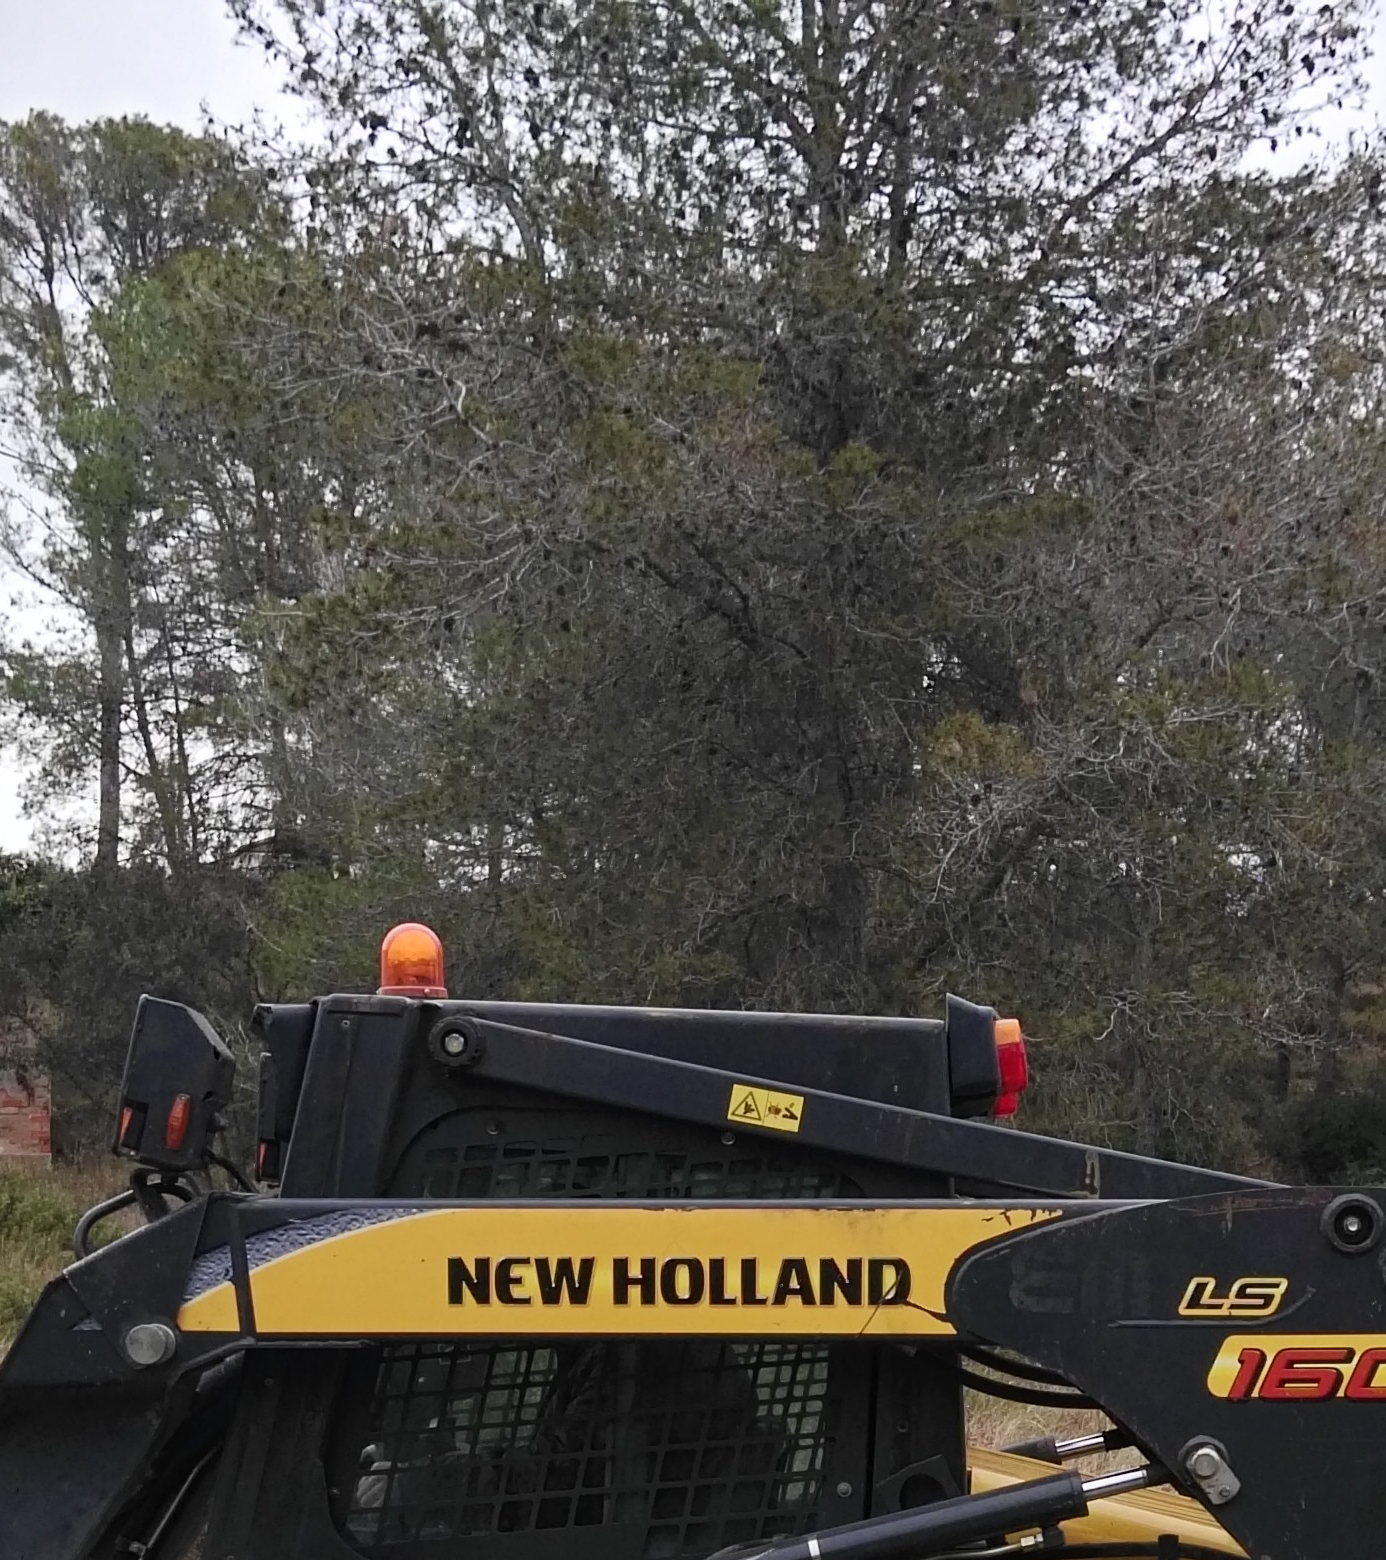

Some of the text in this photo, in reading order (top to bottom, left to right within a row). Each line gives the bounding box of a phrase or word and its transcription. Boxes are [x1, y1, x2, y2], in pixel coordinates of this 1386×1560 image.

[448, 1257, 911, 1305] NEW HOLLAND
[1180, 1278, 1287, 1315] LS
